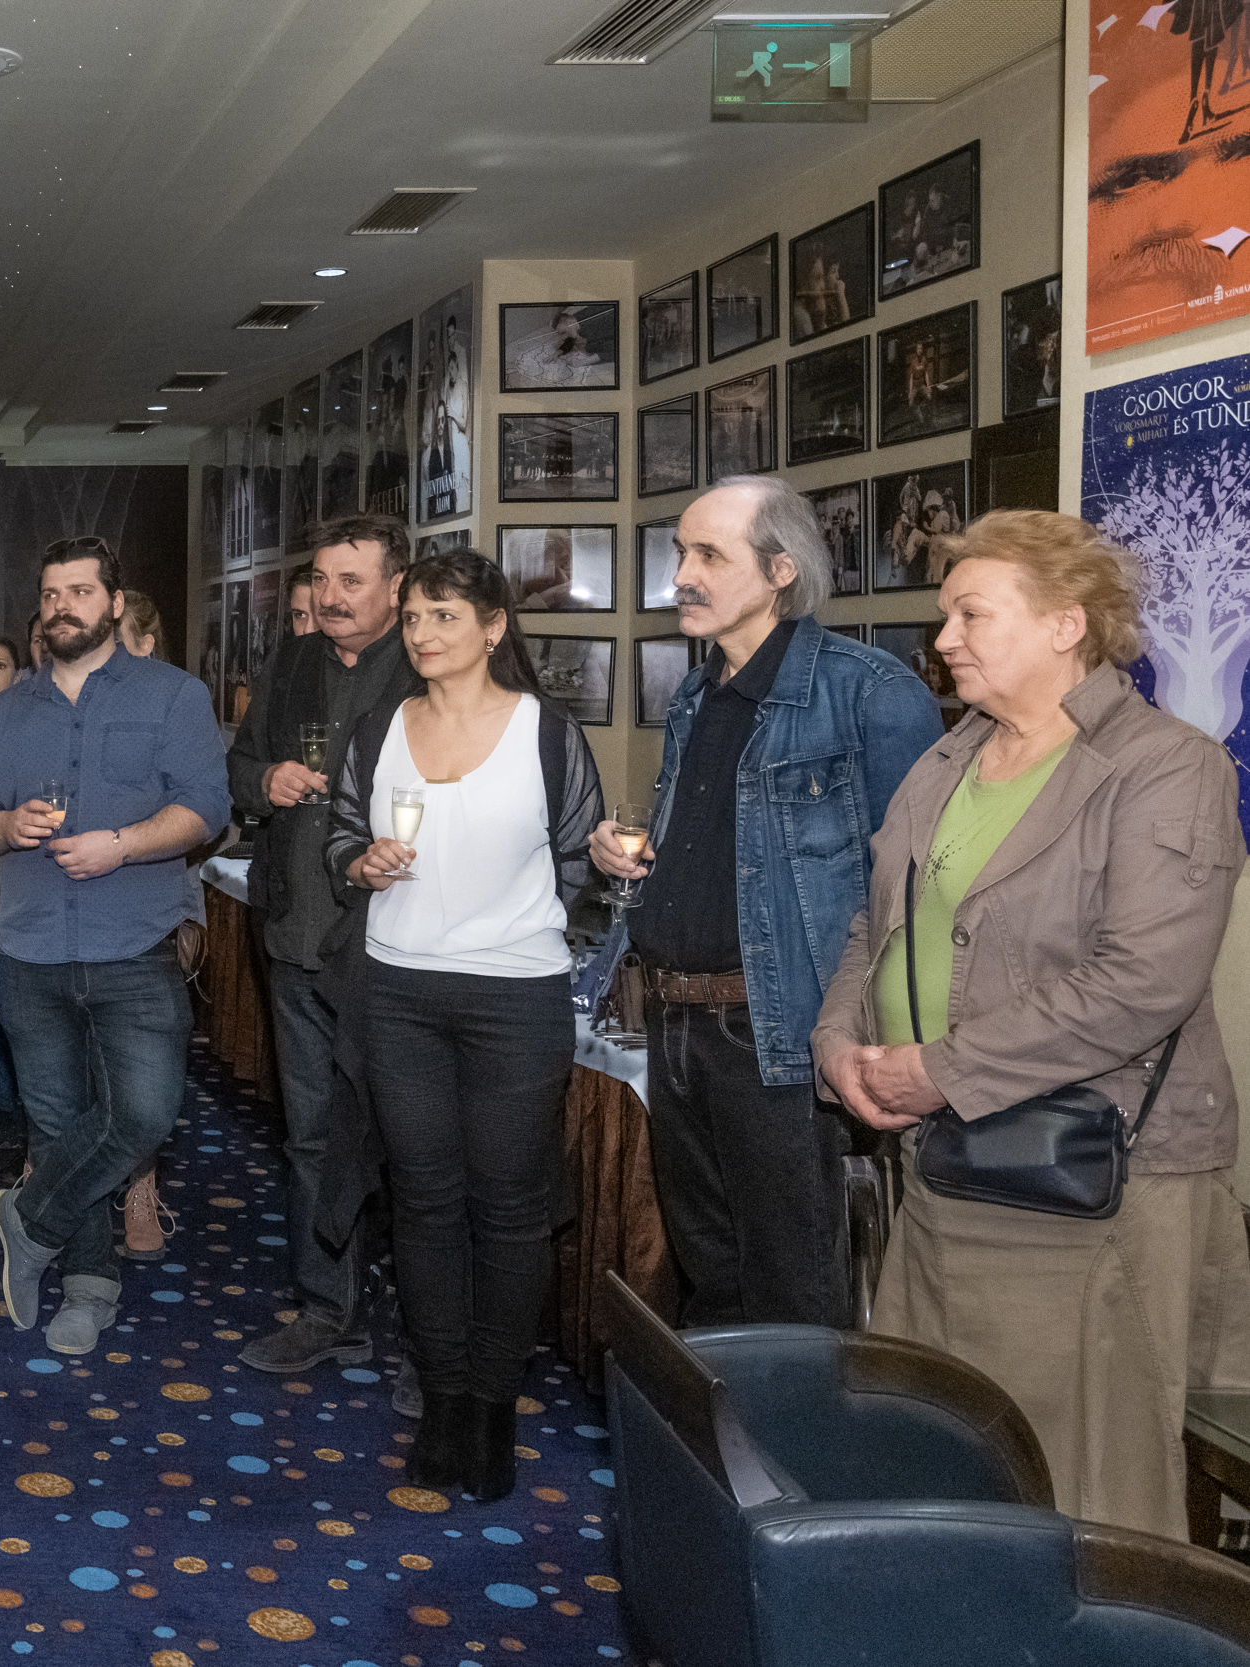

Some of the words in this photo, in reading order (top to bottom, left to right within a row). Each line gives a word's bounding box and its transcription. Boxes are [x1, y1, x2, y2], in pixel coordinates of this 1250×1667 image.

[1187, 295, 1213, 308] NEMZETI
[1123, 376, 1233, 417] CSONGOR
[1173, 414, 1189, 435] ÉS
